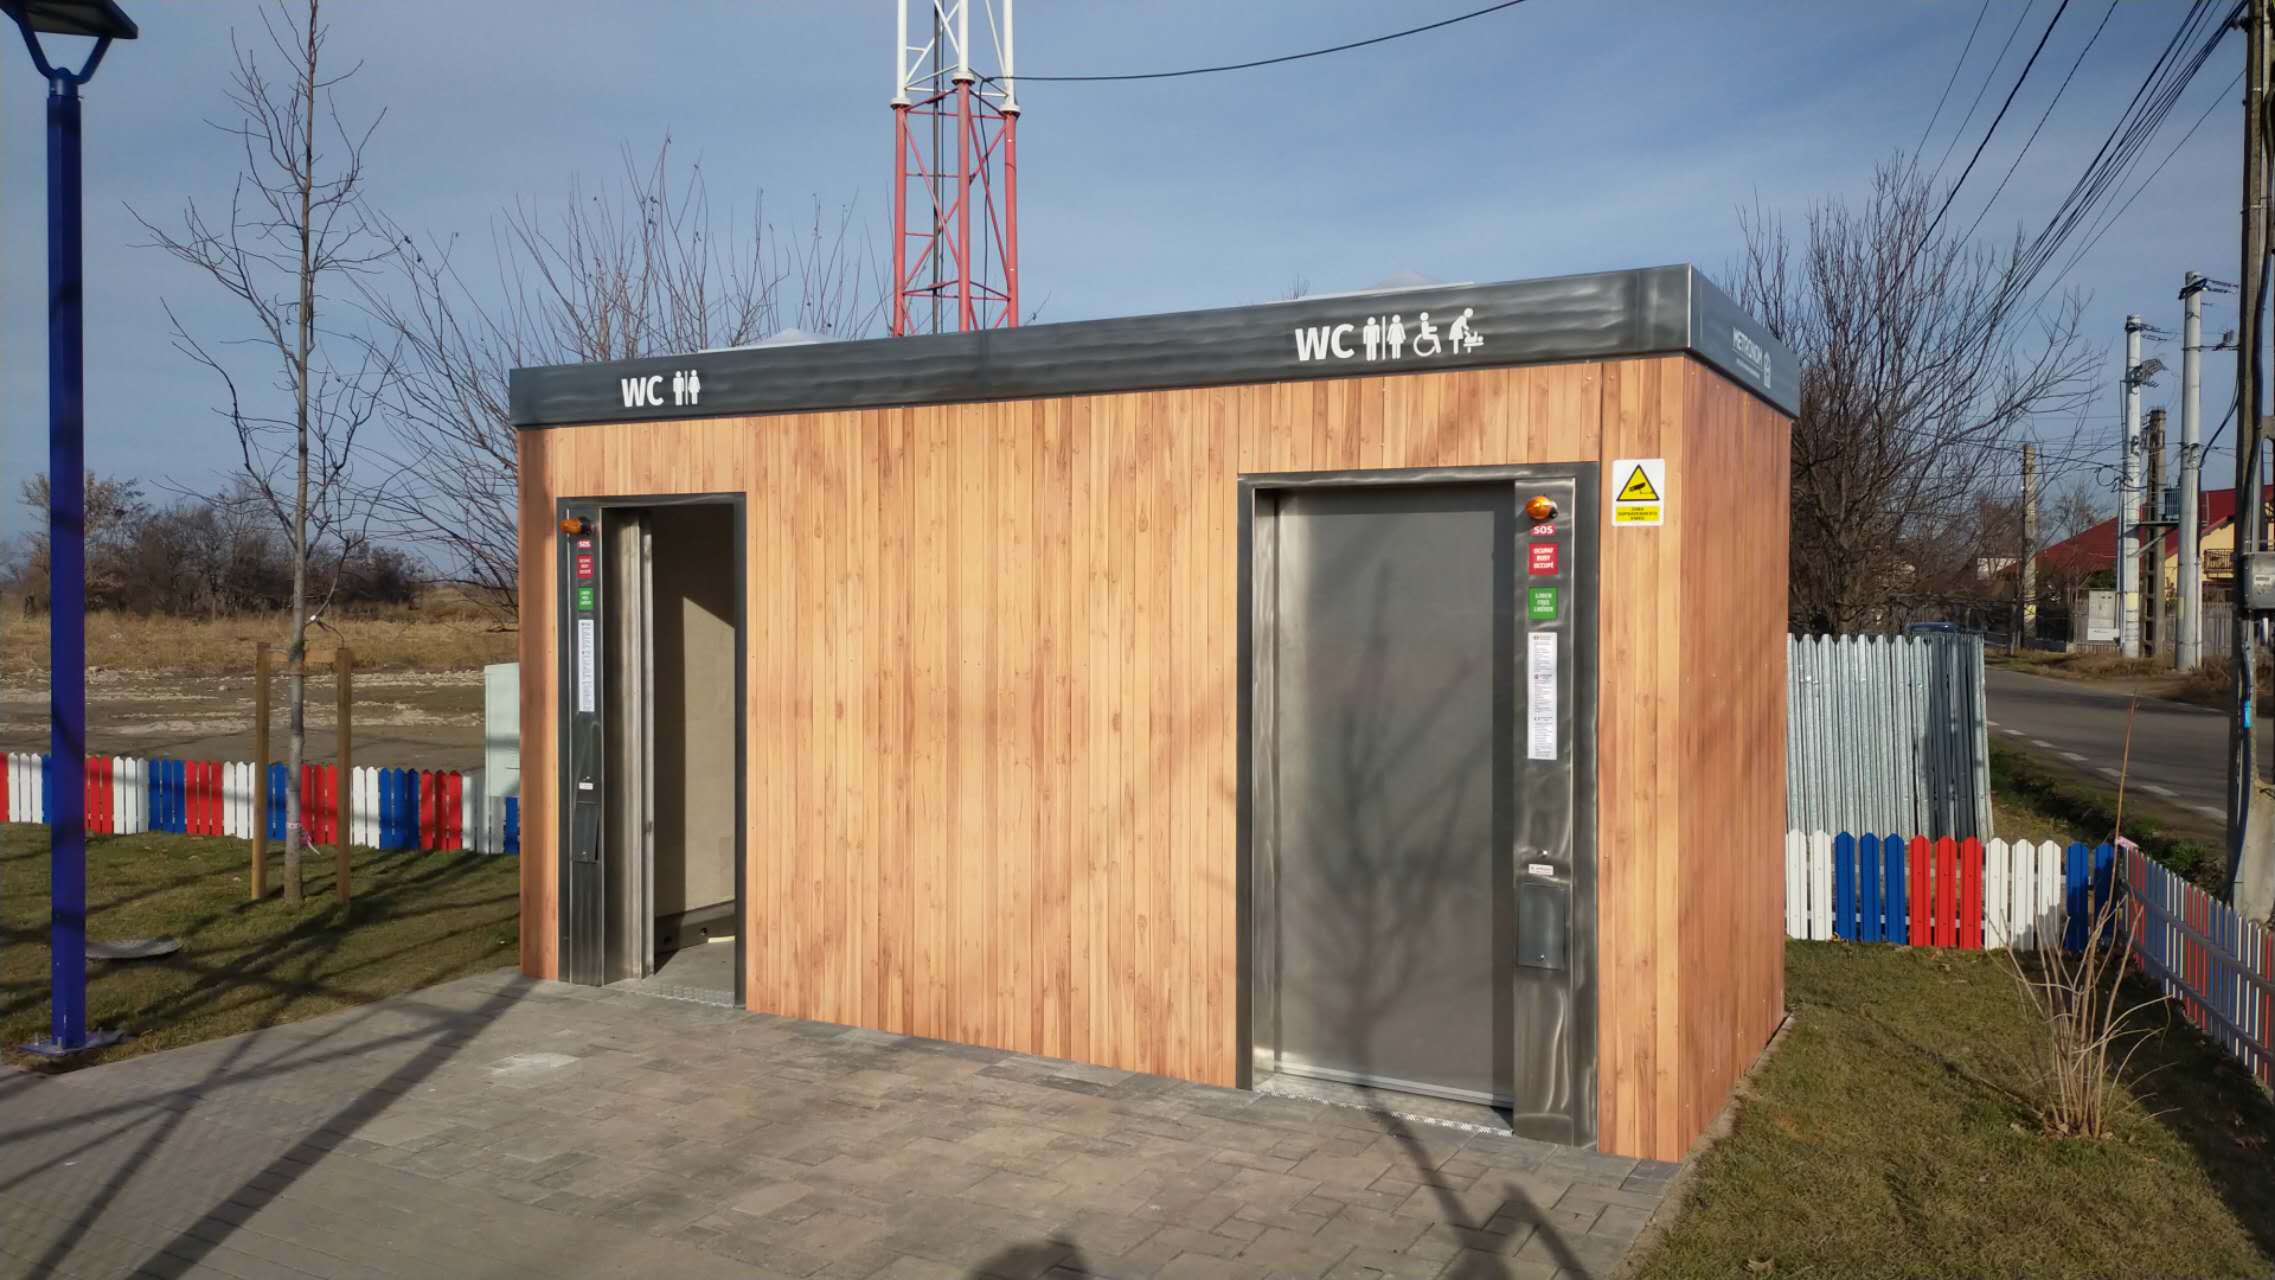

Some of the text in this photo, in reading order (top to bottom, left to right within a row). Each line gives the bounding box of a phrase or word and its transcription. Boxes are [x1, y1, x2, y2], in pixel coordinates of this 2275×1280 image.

[1295, 323, 1355, 361] WC
[621, 375, 664, 408] WC
[1533, 525, 1554, 535] SOS
